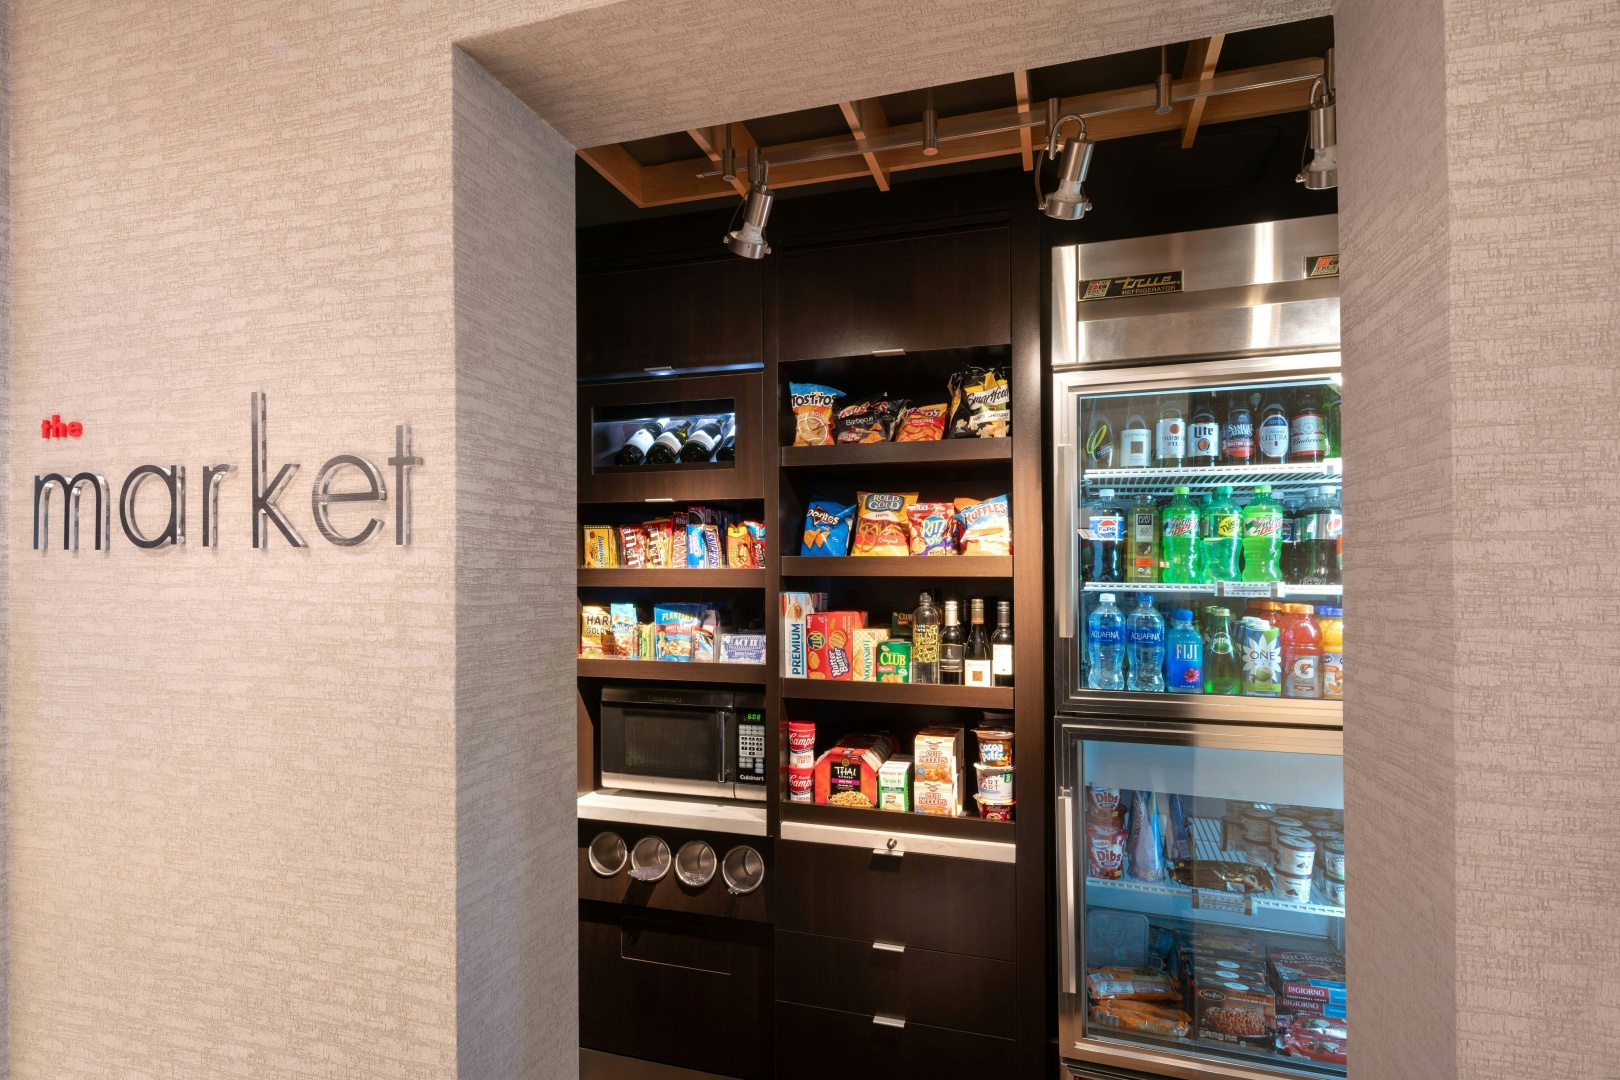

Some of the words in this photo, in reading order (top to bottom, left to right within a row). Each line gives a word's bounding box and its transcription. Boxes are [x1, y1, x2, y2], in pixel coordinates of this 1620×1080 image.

[1122, 285, 1176, 295] REFRIGERATOR
[845, 416, 874, 426] Barbecue
[41, 414, 83, 440] the
[1193, 426, 1213, 438] Lite
[1228, 423, 1253, 432] SAMUEL
[1230, 429, 1253, 438] ADAMS
[1261, 434, 1288, 442] ULTRA
[34, 392, 423, 551] market
[873, 494, 900, 502] ROLD
[868, 501, 901, 510] GOLD
[806, 509, 840, 525] Doritos
[963, 503, 1006, 524] RUFFLES
[921, 520, 946, 536] RITZ
[810, 632, 822, 649] RITZ
[1090, 630, 1120, 640] AQUAFINA
[1130, 632, 1161, 642] AQUAFINA
[734, 639, 747, 647] ACT
[791, 623, 801, 675] PREMIUM
[1176, 644, 1198, 660] FIJI
[834, 647, 849, 673] Butter
[880, 652, 906, 665] CLUB
[1249, 650, 1275, 660] ONE
[829, 650, 841, 677] Nutter
[1294, 659, 1314, 679] G
[834, 766, 857, 776] THAI
[1096, 792, 1119, 803] Dibs
[1097, 850, 1122, 862] Dibs
[1202, 991, 1224, 1000] Stouffer's
